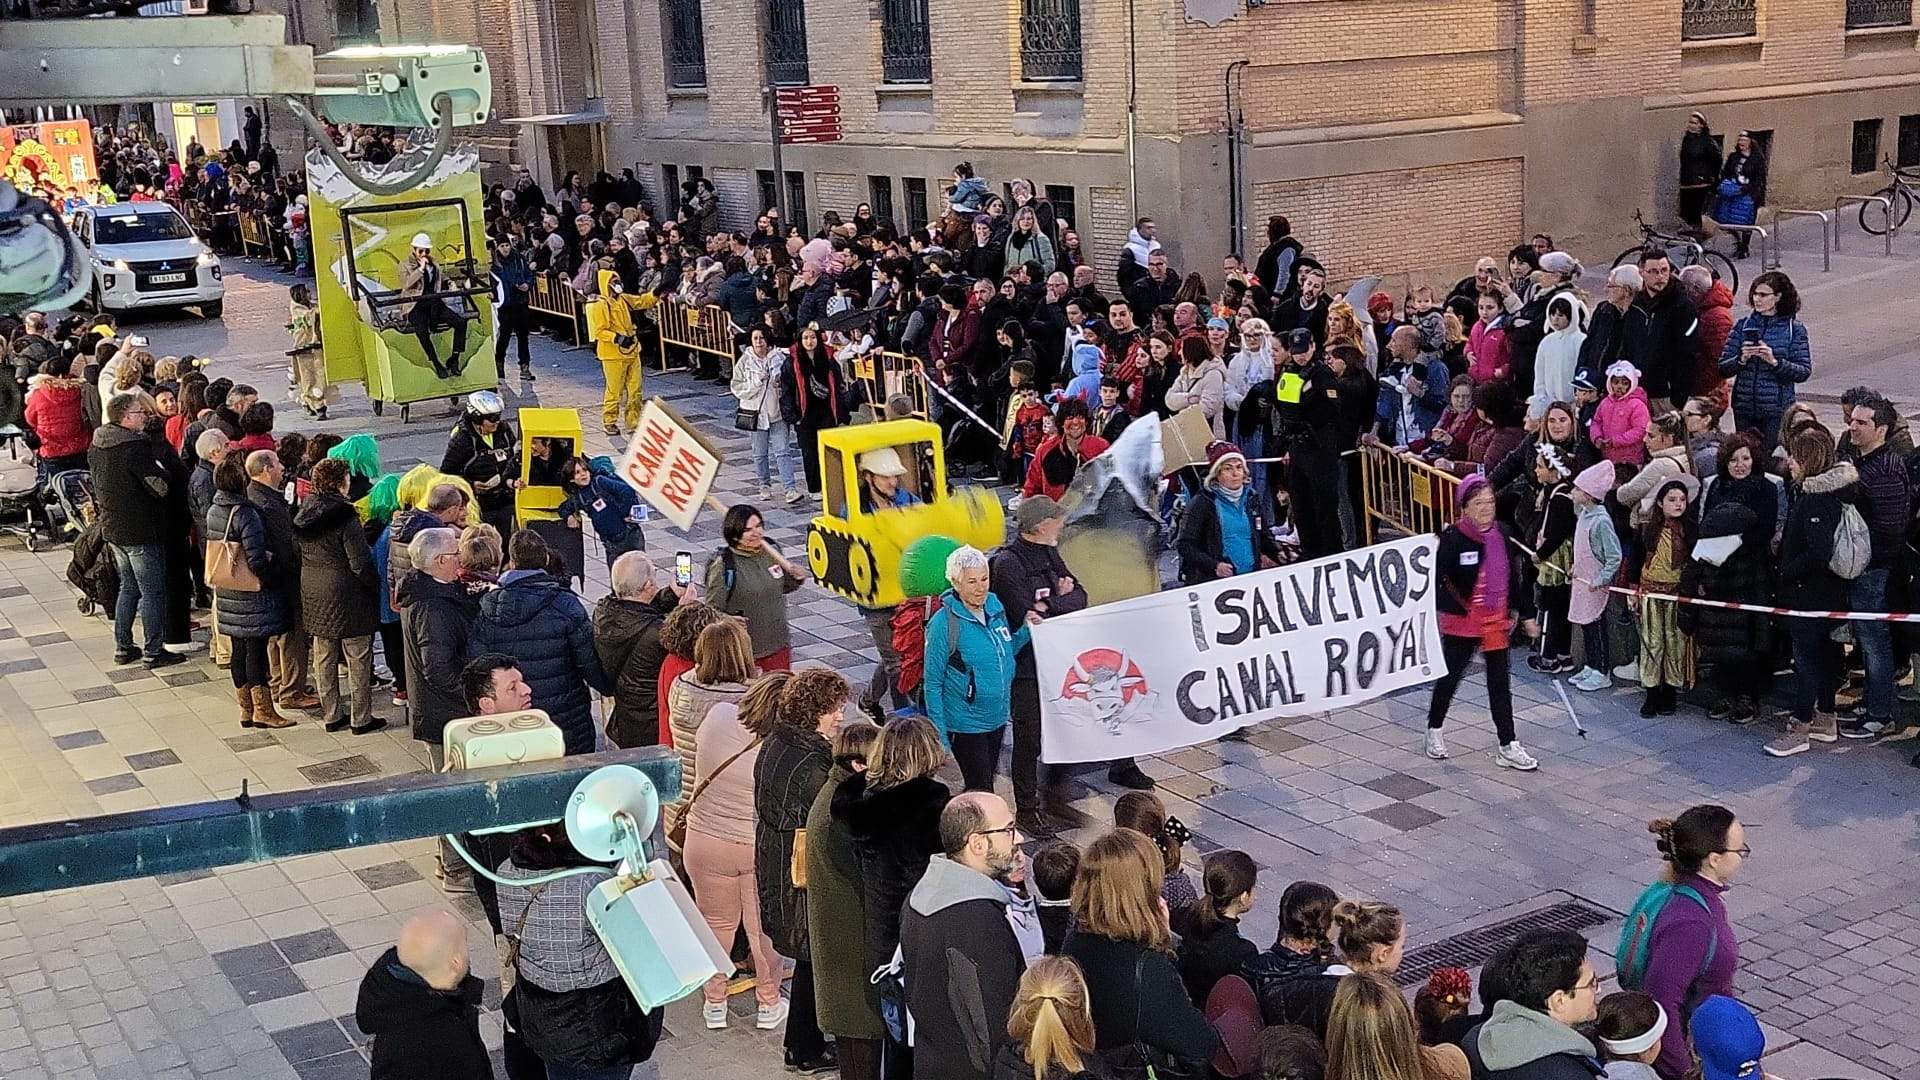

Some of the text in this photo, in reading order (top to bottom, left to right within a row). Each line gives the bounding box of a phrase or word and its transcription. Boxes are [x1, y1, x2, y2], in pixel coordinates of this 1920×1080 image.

[629, 419, 674, 488] CANAL
[661, 447, 705, 512] ROYA
[1188, 545, 1430, 652] ¡SALVEMOS
[1176, 611, 1432, 725] CANAL ROYA!
